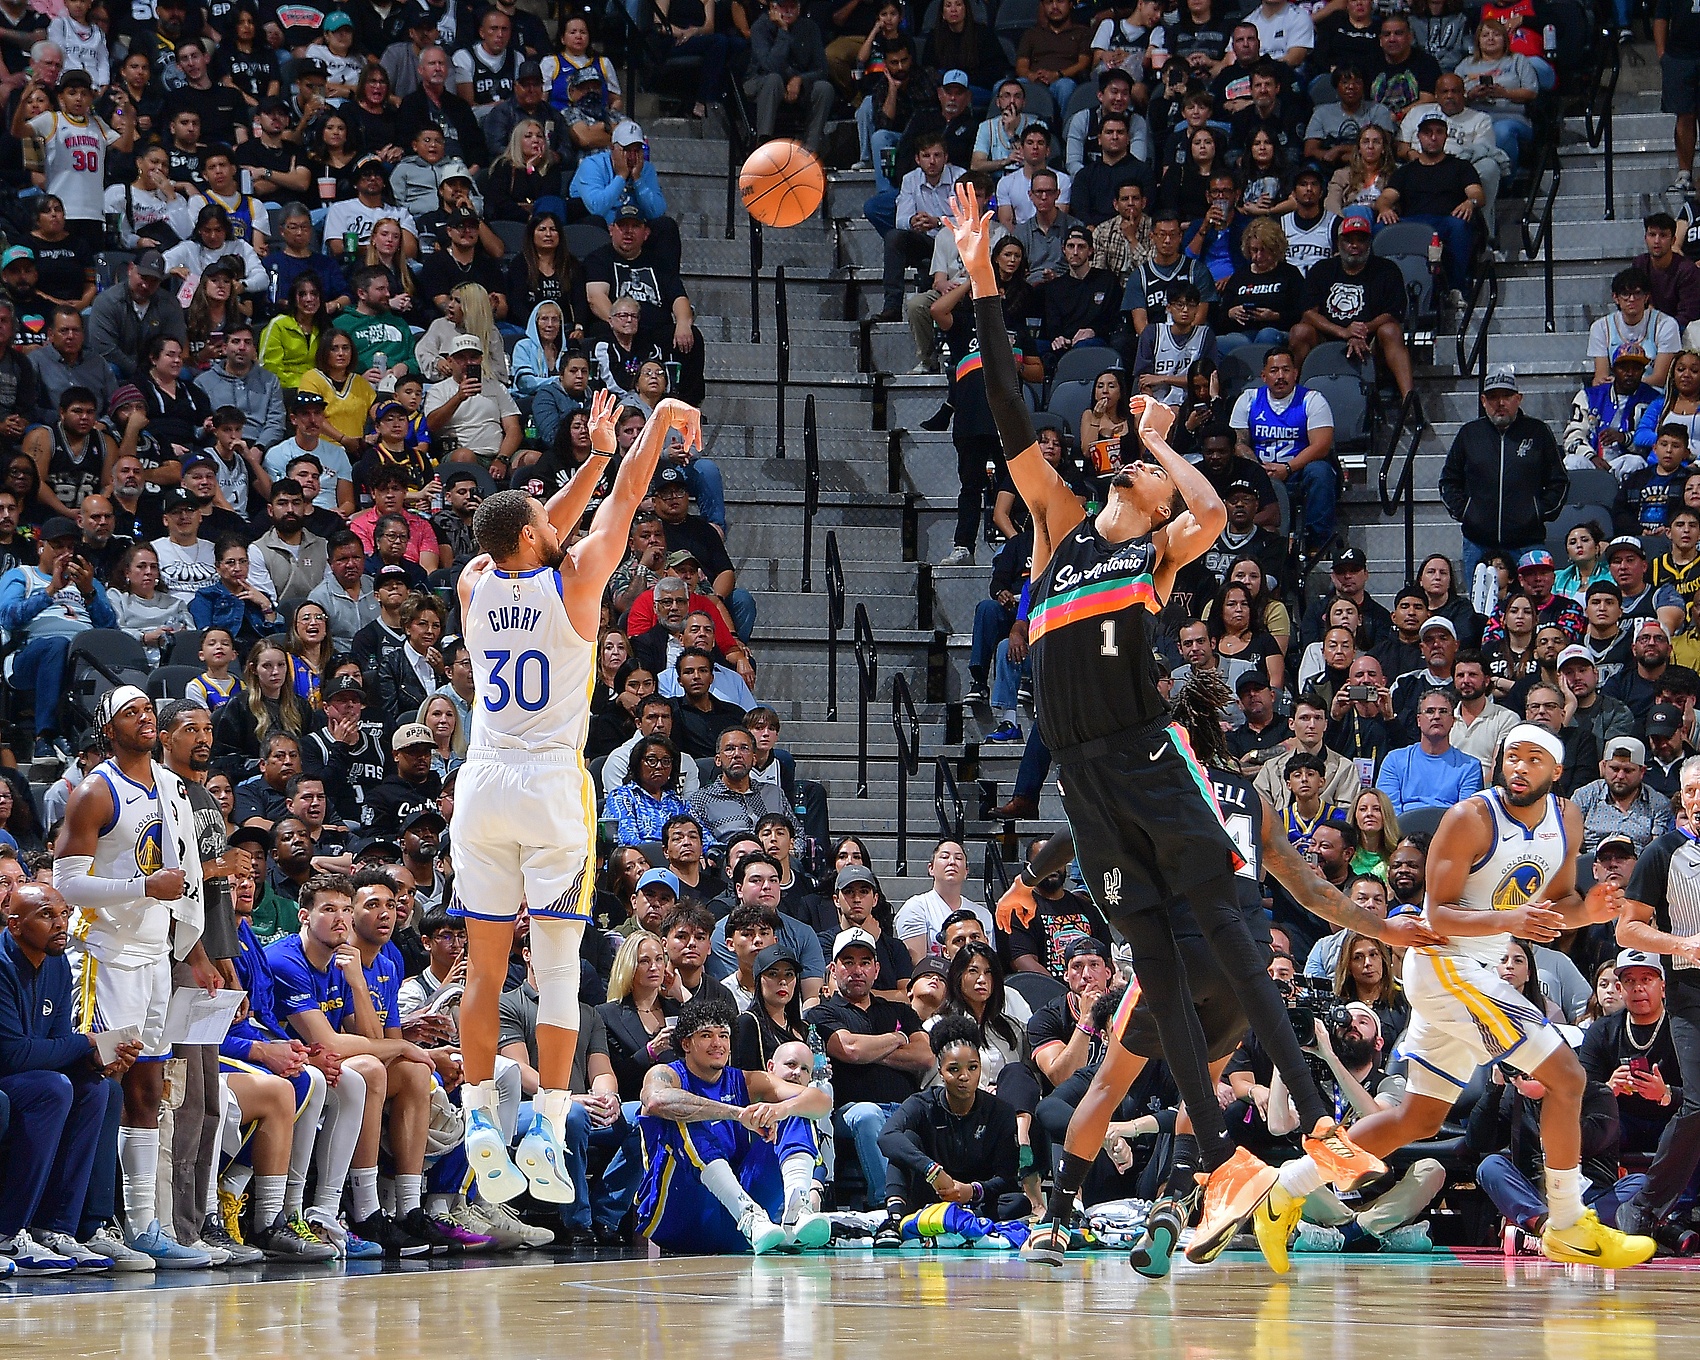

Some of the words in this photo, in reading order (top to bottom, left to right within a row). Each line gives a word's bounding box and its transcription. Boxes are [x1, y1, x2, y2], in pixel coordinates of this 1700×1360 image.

[73, 150, 98, 172] 30
[1254, 424, 1302, 440] FRANCE
[1258, 441, 1298, 463] 32
[1083, 554, 1144, 580] Antonio
[488, 606, 542, 634] CURRY
[1100, 619, 1119, 657] 1
[483, 649, 550, 713] 30
[1214, 784, 1246, 809] ELL
[134, 812, 160, 835] GOLDEN
[1500, 853, 1532, 876] GOLDEN
[1533, 853, 1551, 874] STATE
[1526, 877, 1537, 892] 4
